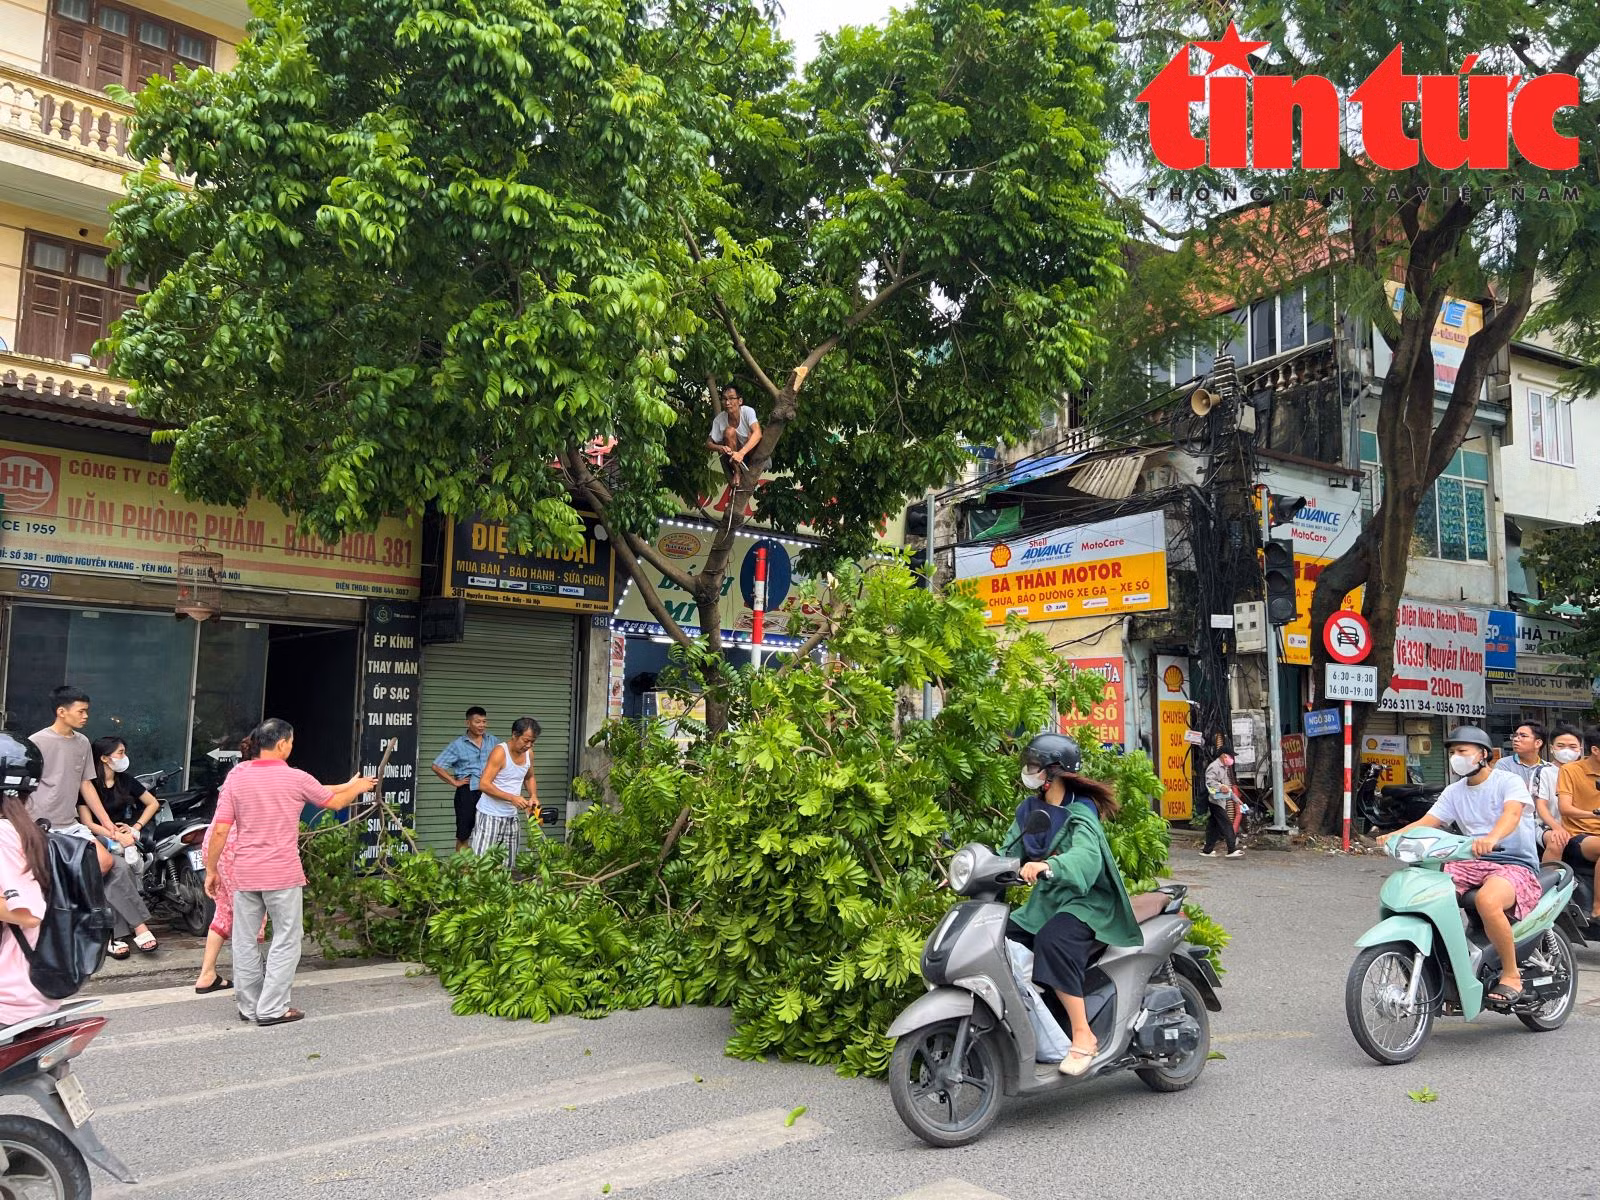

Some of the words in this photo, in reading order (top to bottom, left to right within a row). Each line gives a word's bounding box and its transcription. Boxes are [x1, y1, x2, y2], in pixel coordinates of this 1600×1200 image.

[69, 458, 117, 481] CÔNG
[124, 467, 141, 484] TY
[26, 526, 57, 539] 1959
[67, 491, 116, 538] VĂN
[121, 500, 199, 547] PHÒNG
[204, 508, 265, 554] PHẨM
[383, 537, 413, 569] 381
[1291, 528, 1327, 543] MotoCare
[1021, 541, 1075, 560] ADVANCE
[1029, 537, 1047, 548] Shell
[1081, 538, 1124, 552] MotoCare
[10, 549, 21, 560] SỐ
[23, 552, 37, 561] 381
[108, 560, 134, 571] KHANG
[141, 563, 155, 573] YÊN
[457, 560, 477, 574] MUA
[481, 562, 500, 575] BÁN
[531, 567, 555, 581] HÀNH
[1015, 569, 1057, 591] THÂN
[1062, 562, 1123, 585] MOTOR
[21, 573, 50, 589] 379
[1077, 587, 1089, 598] XE
[1092, 585, 1107, 596] GA
[1121, 582, 1132, 593] XE
[1136, 577, 1150, 591] SỐ
[452, 587, 466, 598] 381
[594, 616, 609, 627] 381
[1402, 604, 1416, 631] Điện
[1418, 607, 1435, 631] Nước
[1436, 609, 1457, 635] Hoàng
[1458, 611, 1478, 637] Nhung
[374, 633, 387, 648] ÉP
[390, 634, 414, 649] KÍNH
[1407, 642, 1424, 668] 339
[1425, 640, 1457, 672] Nguyễn
[1460, 646, 1483, 676] Khang
[368, 661, 392, 674] THAY
[395, 659, 418, 675] MÀN
[1333, 672, 1349, 682] 6:30
[1357, 673, 1373, 683] 8:30
[1518, 675, 1547, 688] THUỐC
[373, 682, 387, 700] ỐP
[390, 687, 410, 702] SẠC
[1430, 677, 1464, 698] 200m
[1092, 702, 1118, 721] SỐ
[1400, 700, 1415, 710] 311
[1437, 702, 1454, 714] 0356
[1455, 703, 1470, 715] 793
[368, 713, 383, 726] TAI
[386, 713, 413, 726] NGHE
[1163, 779, 1189, 793] PIAGGIO
[1168, 801, 1187, 816] VESPA
